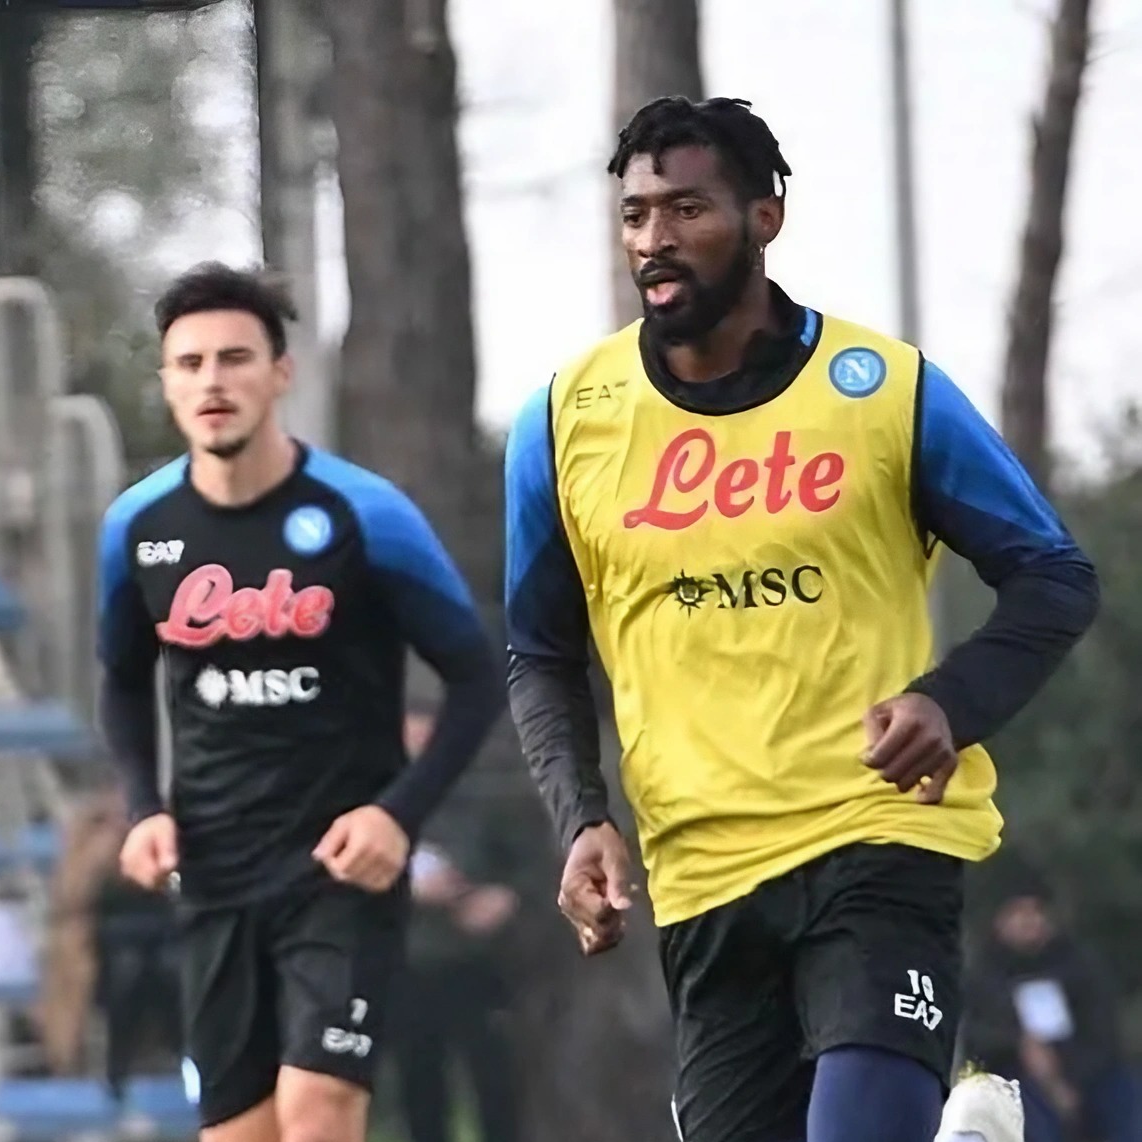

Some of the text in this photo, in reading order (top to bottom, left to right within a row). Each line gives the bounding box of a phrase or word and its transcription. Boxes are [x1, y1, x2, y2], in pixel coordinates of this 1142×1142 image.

[623, 428, 844, 530] Lete
[155, 564, 335, 646] Lete
[712, 565, 823, 608] MSC
[228, 666, 321, 706] MSC
